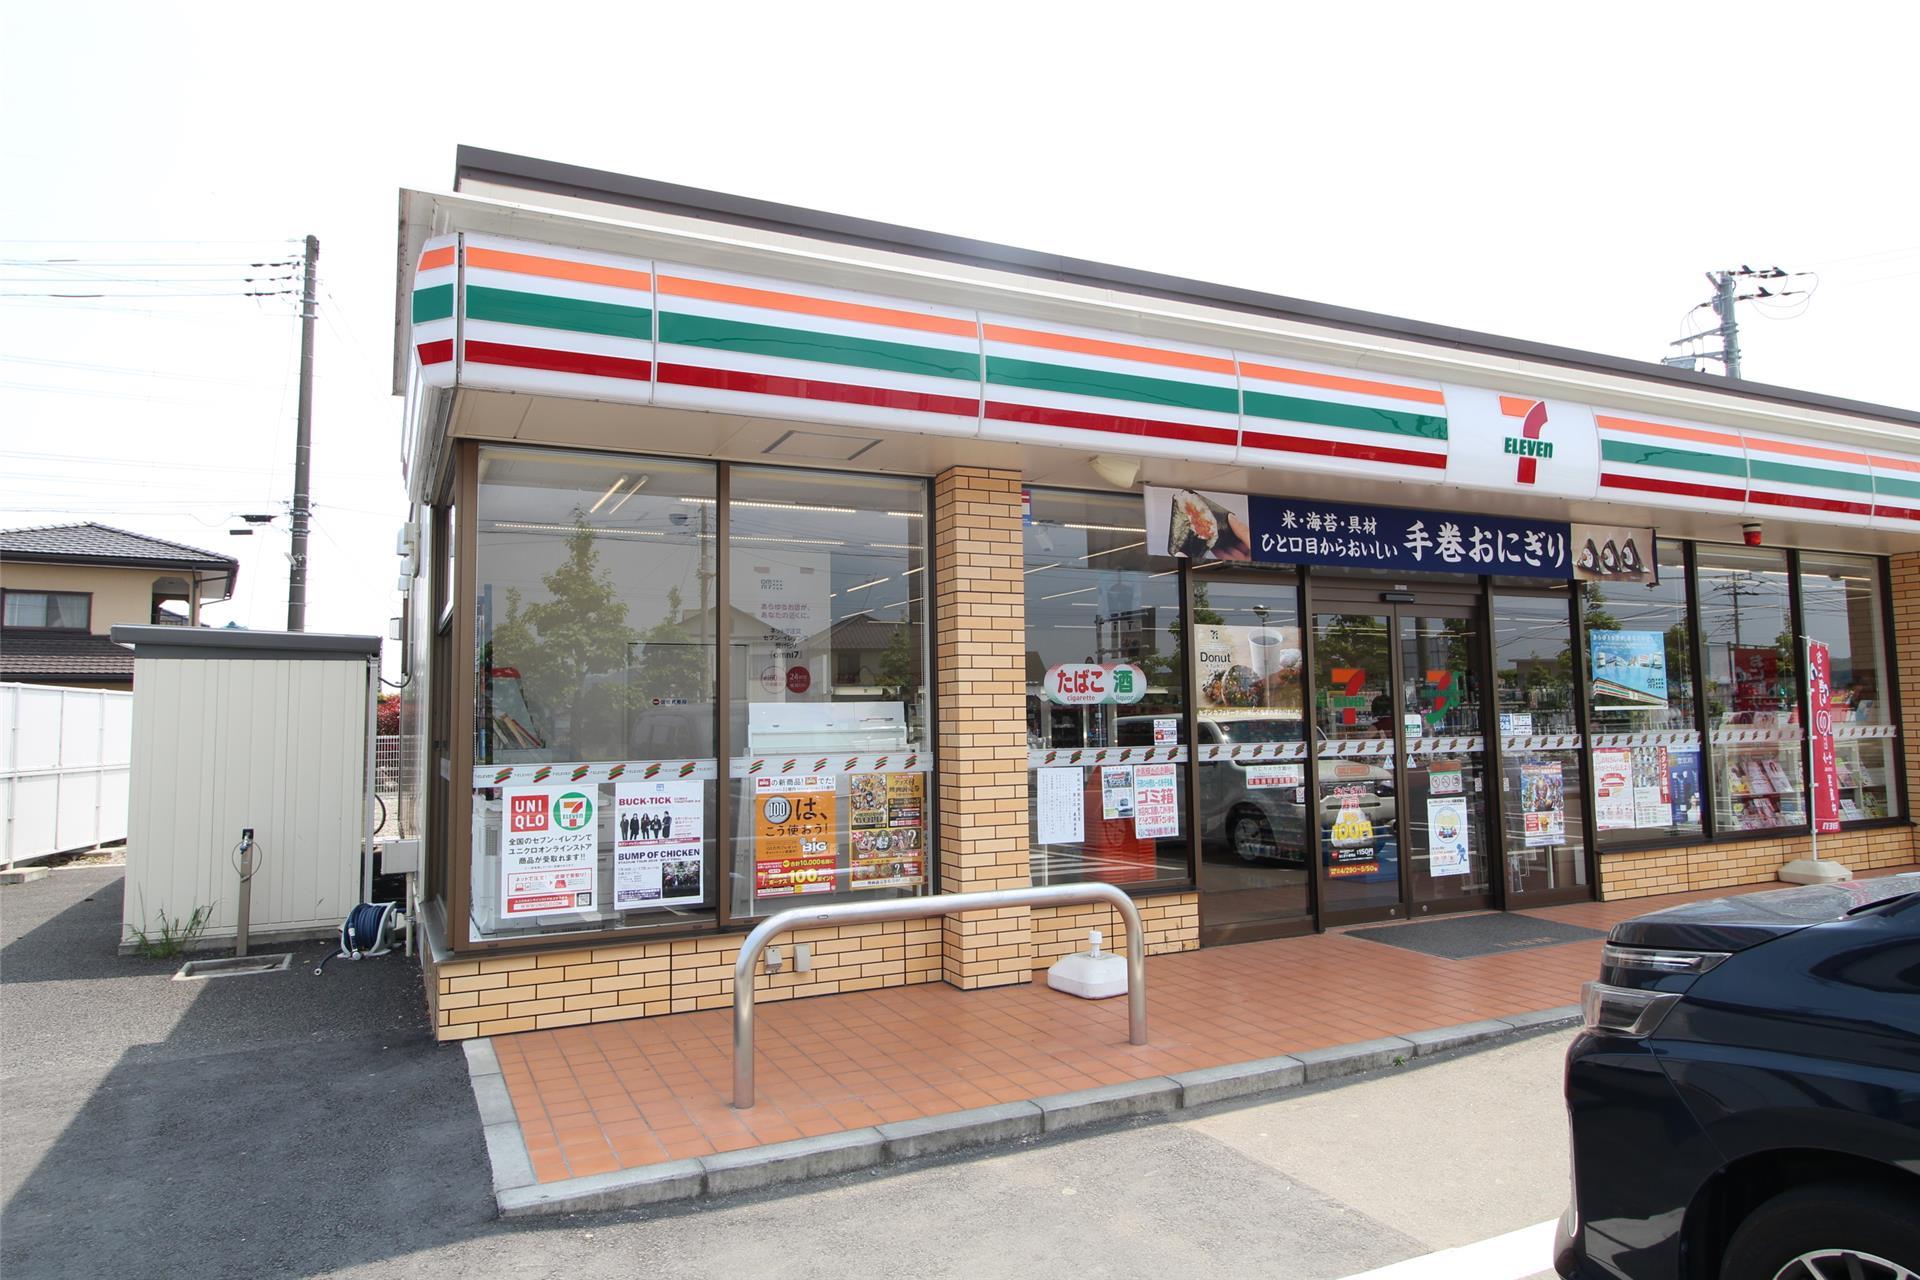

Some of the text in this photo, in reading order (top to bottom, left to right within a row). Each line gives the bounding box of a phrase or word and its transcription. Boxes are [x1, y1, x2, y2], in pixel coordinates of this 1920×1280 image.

[1282, 509, 1377, 535] 米・海苔・具材
[1262, 534, 1398, 560] ひと口目からおいしい
[1403, 520, 1565, 568] 手巻おにぎり
[1200, 652, 1231, 663] Donut
[1058, 670, 1104, 693] たばこ
[1113, 670, 1133, 693] 酒
[618, 796, 671, 806] BUCK-TICK
[1138, 788, 1173, 804] ゴミ箱
[515, 800, 542, 812] UNI
[769, 802, 787, 818] 100
[796, 798, 828, 820] は、
[515, 815, 544, 830] QLO
[766, 823, 828, 837] こう使おう!
[508, 843, 592, 855] ユニクロオンラインストア
[618, 852, 646, 860] BUMP
[660, 848, 700, 858] CHICKEN
